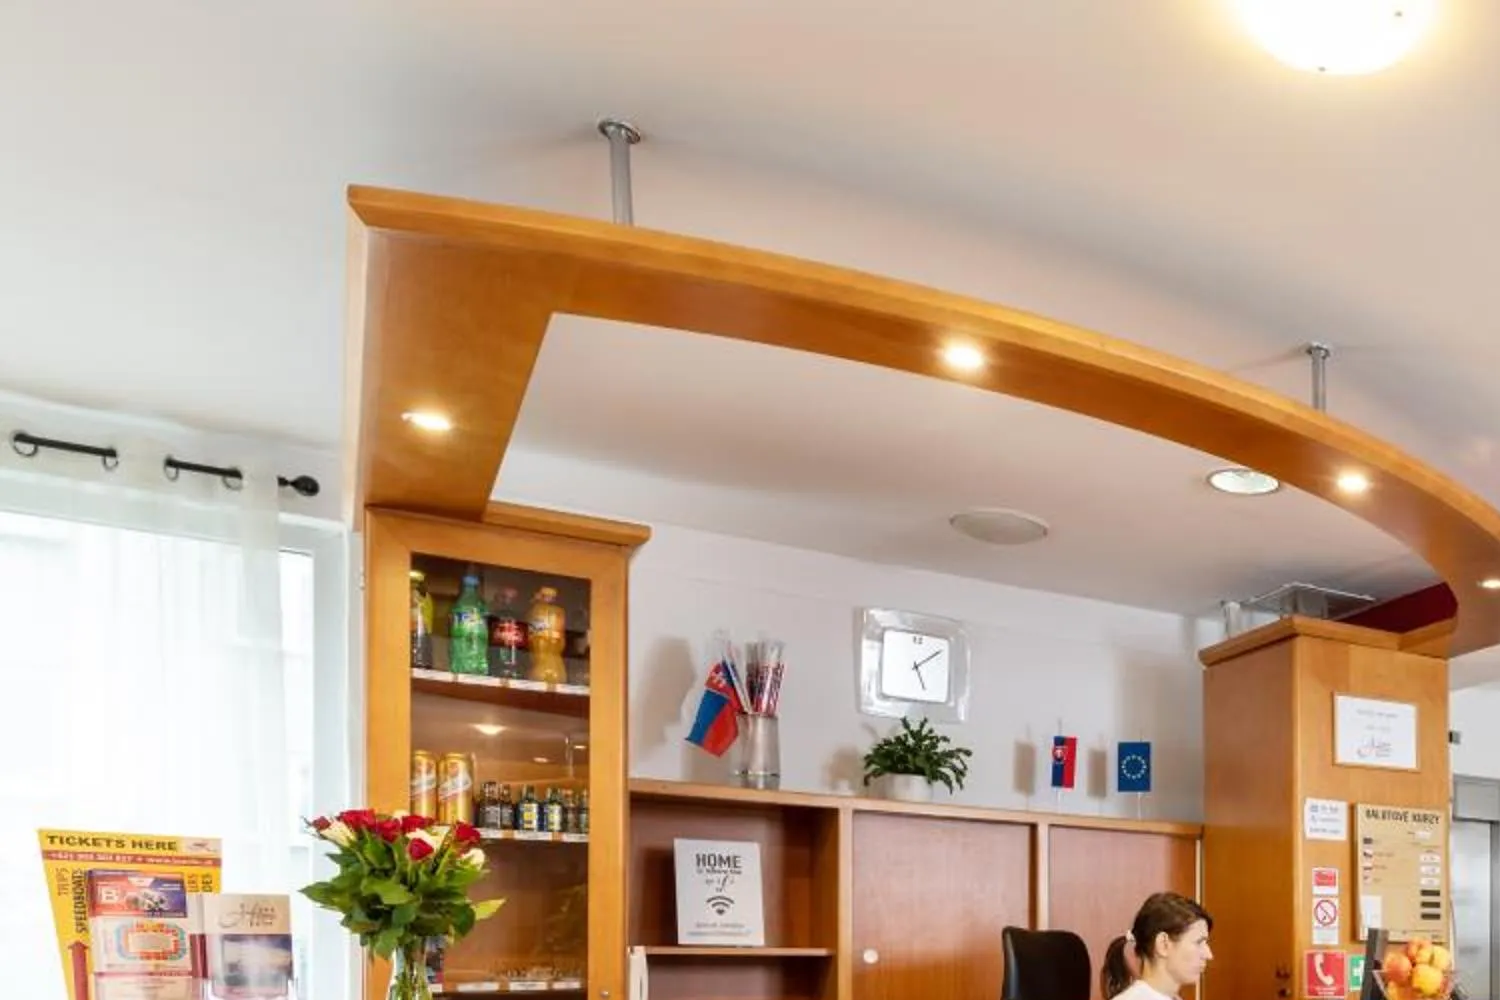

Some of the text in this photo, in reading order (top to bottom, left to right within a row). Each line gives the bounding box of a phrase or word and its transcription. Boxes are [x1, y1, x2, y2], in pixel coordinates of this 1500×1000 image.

[47, 835, 177, 851] TICKETS HERE
[696, 853, 742, 869] HOME
